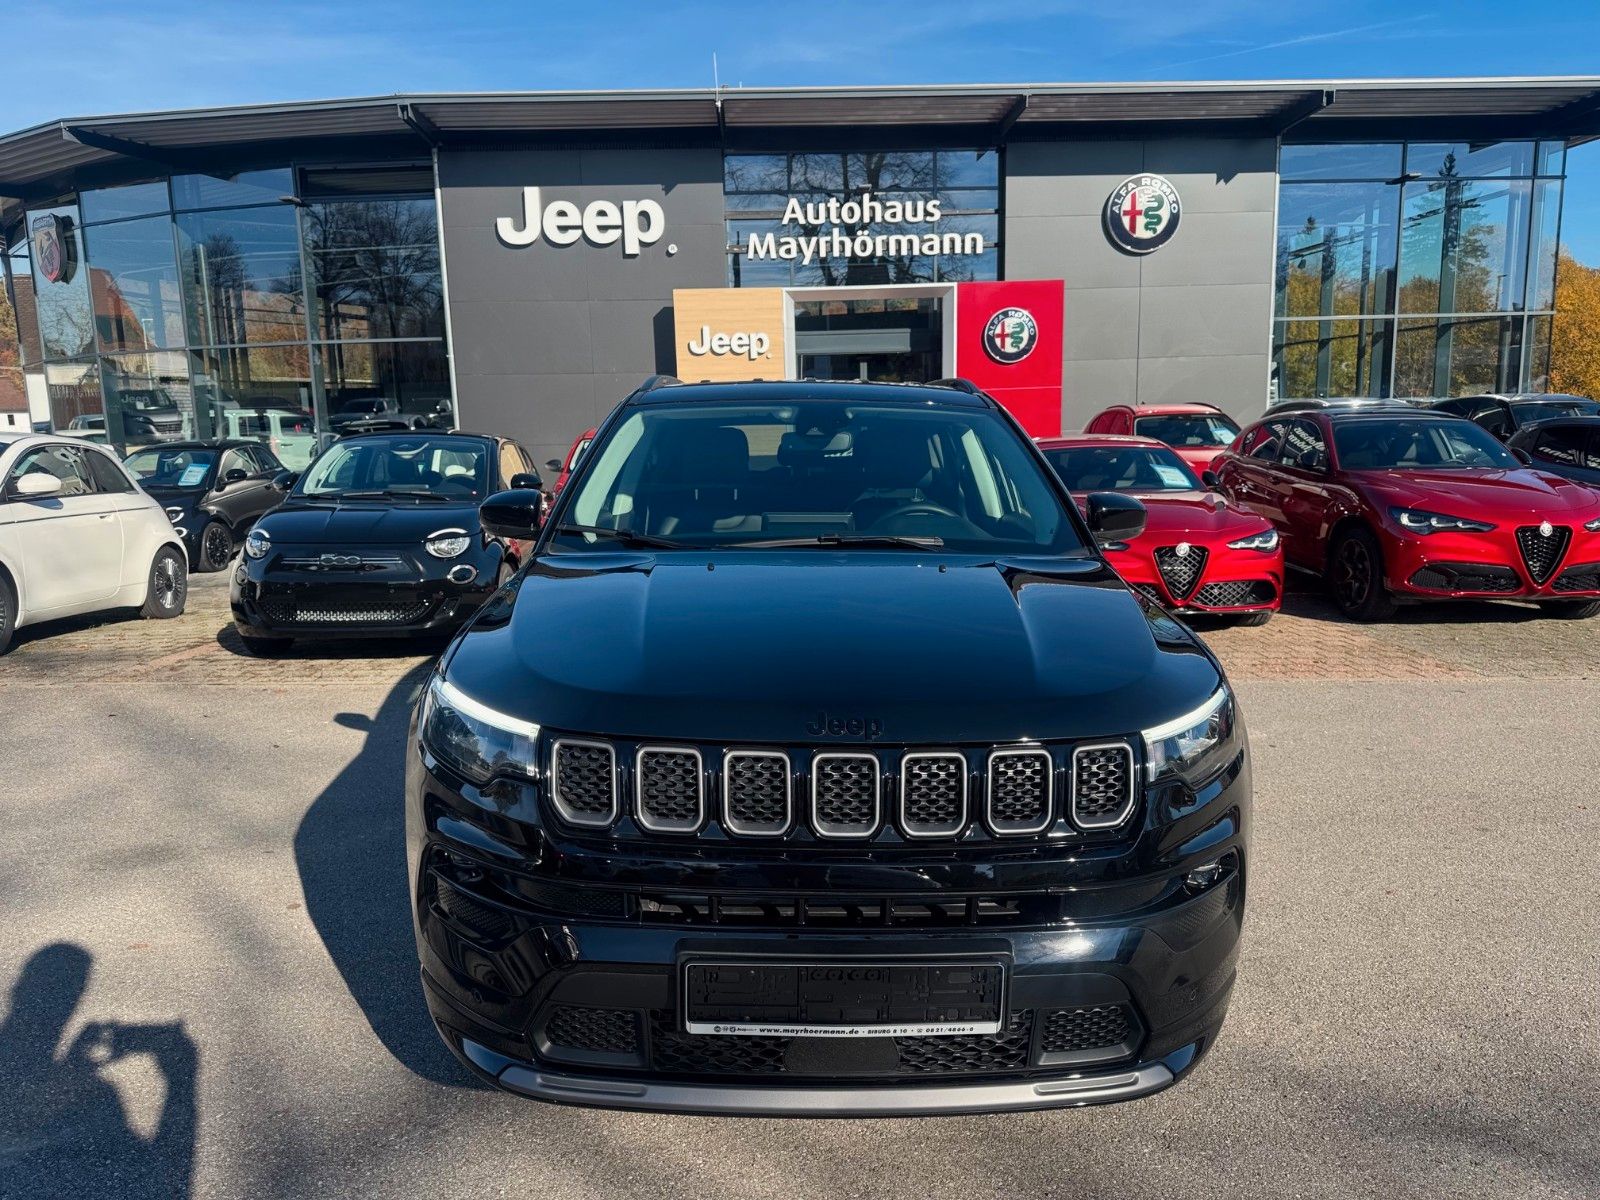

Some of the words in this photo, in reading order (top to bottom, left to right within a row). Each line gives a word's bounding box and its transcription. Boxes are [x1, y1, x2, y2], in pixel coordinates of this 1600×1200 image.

[782, 193, 941, 225] Autohaus
[1113, 182, 1137, 214] ALFA
[1141, 177, 1179, 214] ROMEO
[496, 186, 665, 255] Jeep
[747, 228, 984, 266] Mayrhörmann
[988, 314, 1005, 337] ALFA
[1008, 310, 1035, 336] ROMEO
[689, 325, 769, 359] Jeep
[806, 710, 884, 741] Jeep
[759, 1027, 859, 1035] www.mayrhoermann.de
